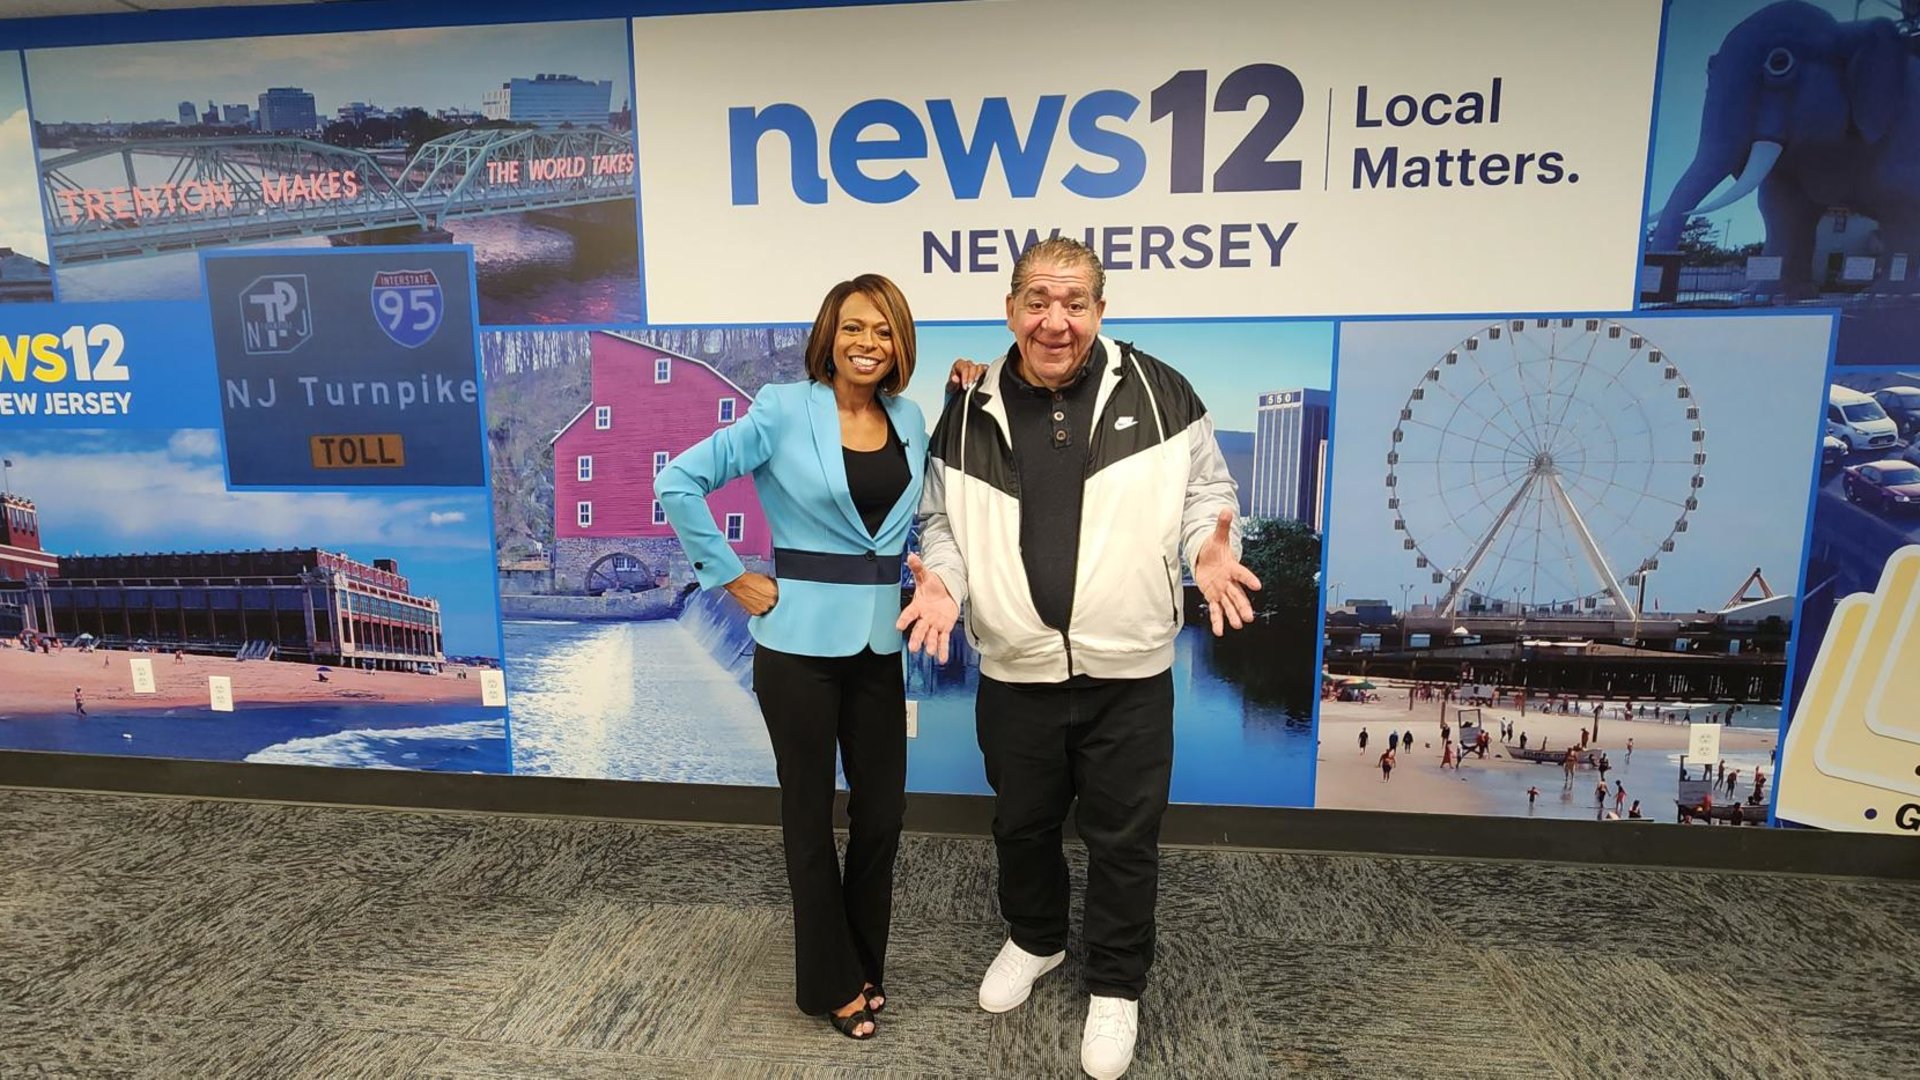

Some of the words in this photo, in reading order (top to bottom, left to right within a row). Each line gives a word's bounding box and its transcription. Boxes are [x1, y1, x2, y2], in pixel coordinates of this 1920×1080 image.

[1355, 77, 1502, 127] Local
[487, 161, 520, 185] THE
[529, 156, 586, 182] WORLD
[592, 152, 635, 176] TAKES
[1352, 146, 1580, 189] Matters.
[57, 179, 234, 224] TRENTON
[262, 170, 358, 205] MAKES
[381, 275, 430, 285] INTERSTATE
[379, 290, 436, 331] 95
[44, 392, 132, 415] JERSEY
[226, 378, 277, 409] NJ
[298, 374, 478, 410] Turnpike
[319, 438, 396, 465] TOLL
